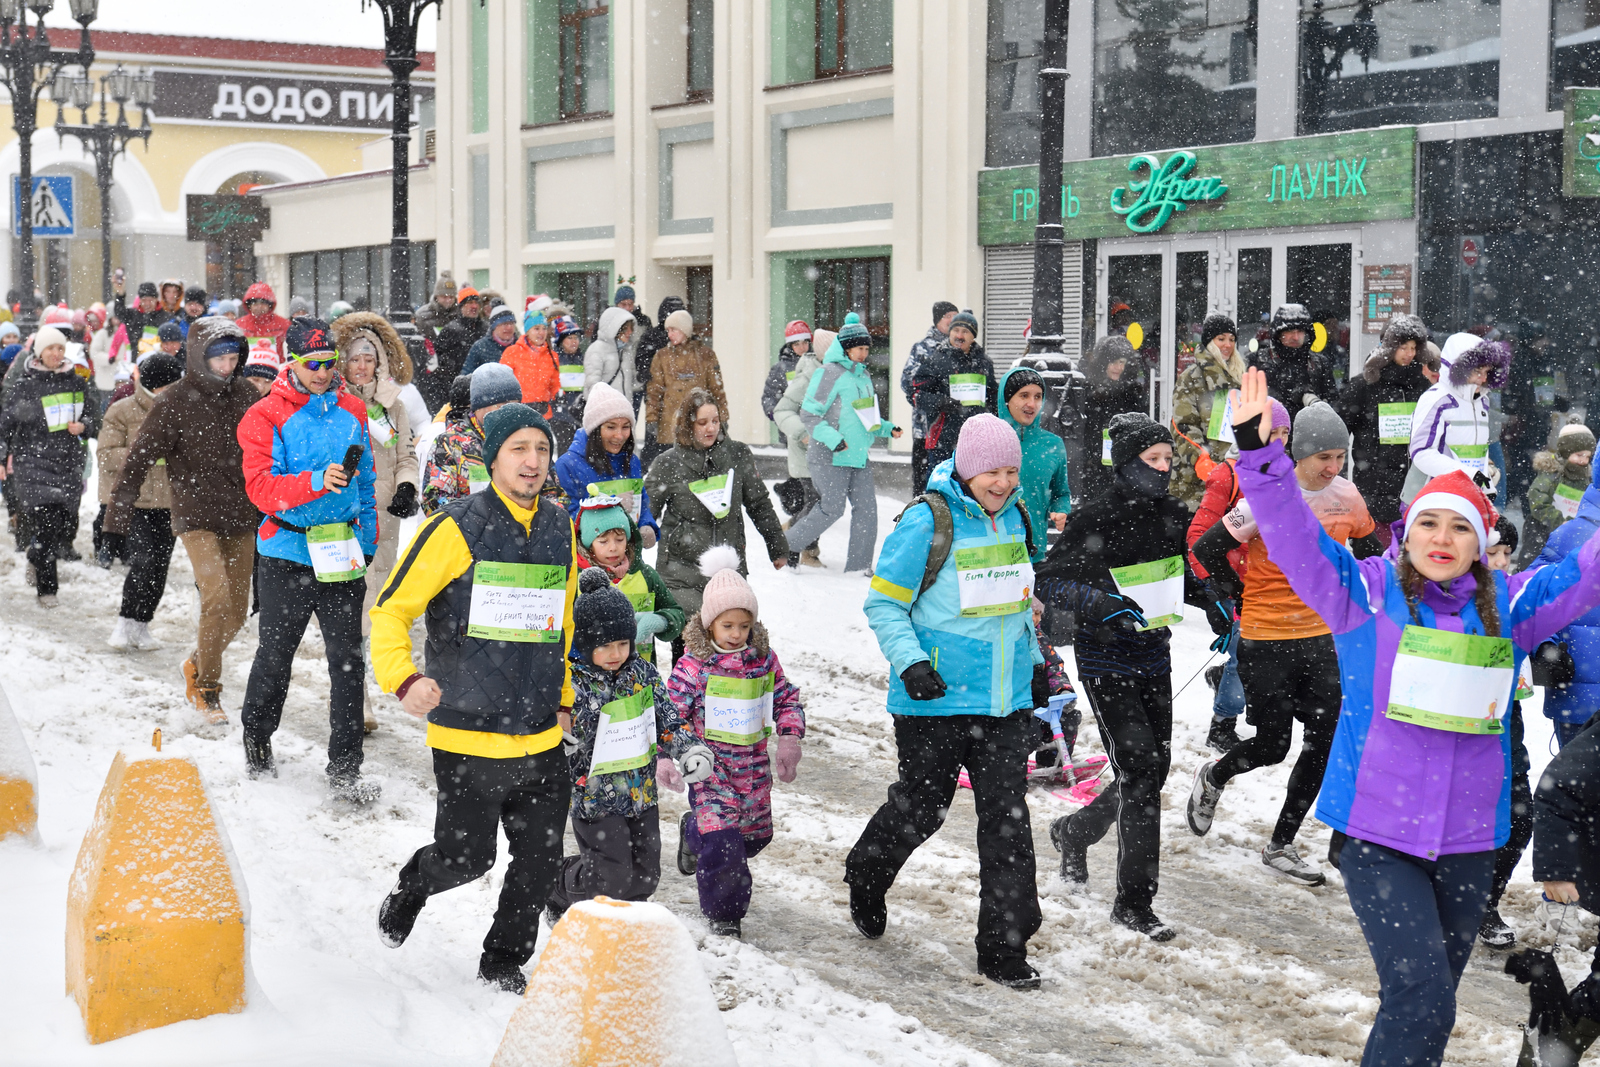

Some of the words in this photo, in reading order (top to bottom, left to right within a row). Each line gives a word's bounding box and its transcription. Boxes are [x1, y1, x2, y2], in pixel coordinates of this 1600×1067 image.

[212, 83, 332, 122] ДОДО
[1267, 157, 1367, 203] ЛАУНЖ
[1110, 151, 1229, 233] Эврен
[1012, 184, 1081, 222] ГРЬ
[310, 341, 329, 349] RUN
[253, 353, 278, 364] UFA
[994, 570, 1020, 582] форме
[1404, 632, 1433, 644] ЗАБЕГ
[1388, 710, 1413, 719] RUNNING
